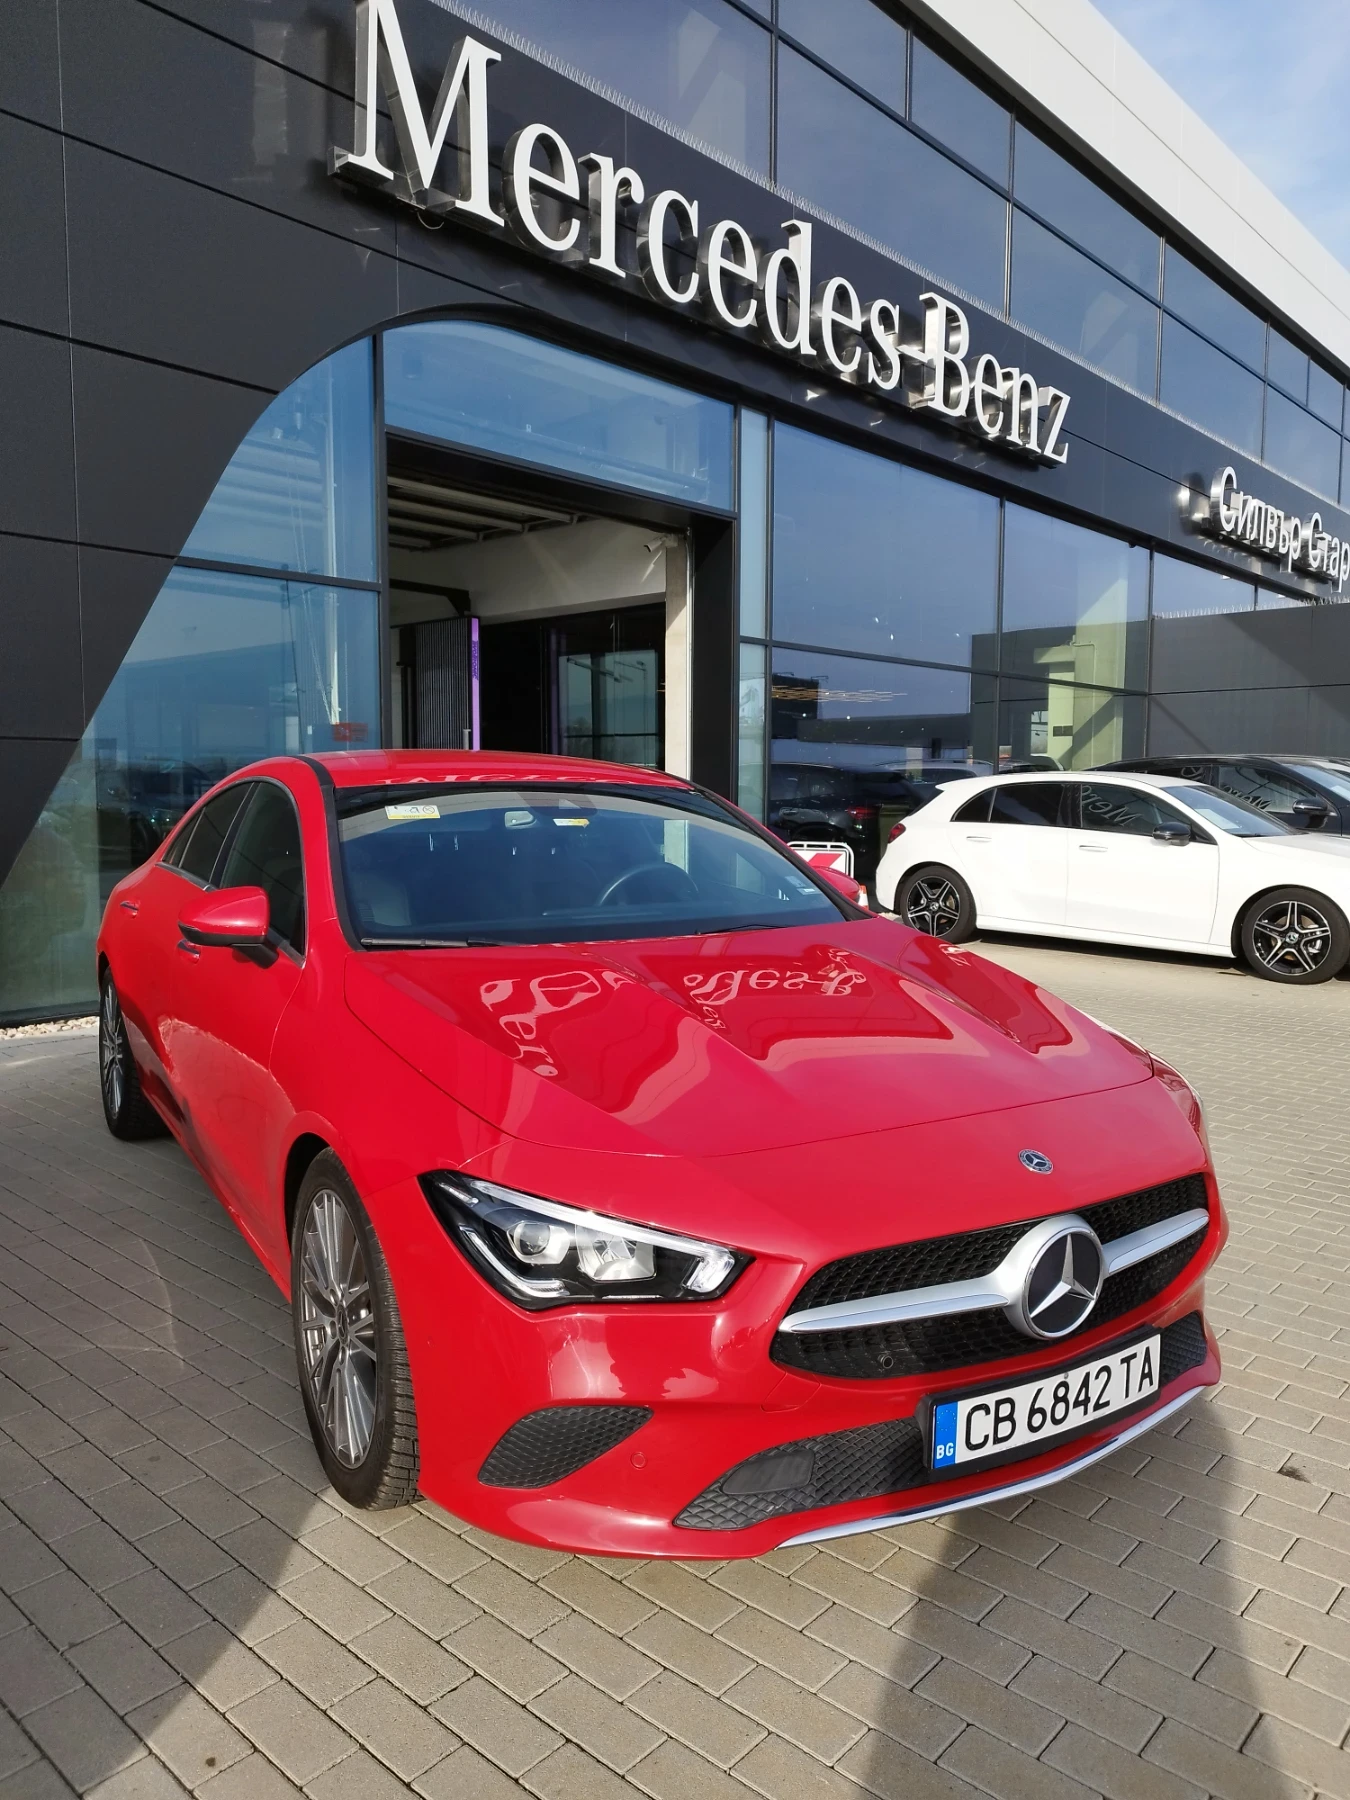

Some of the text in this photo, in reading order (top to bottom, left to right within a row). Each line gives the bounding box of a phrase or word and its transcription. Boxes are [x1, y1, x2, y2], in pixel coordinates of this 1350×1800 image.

[348, 0, 1070, 464] Mercedes-Benz
[1219, 466, 1350, 593] Силвър Стар
[936, 1442, 954, 1460] BG
[965, 1346, 1154, 1451] CB 6842 TA
